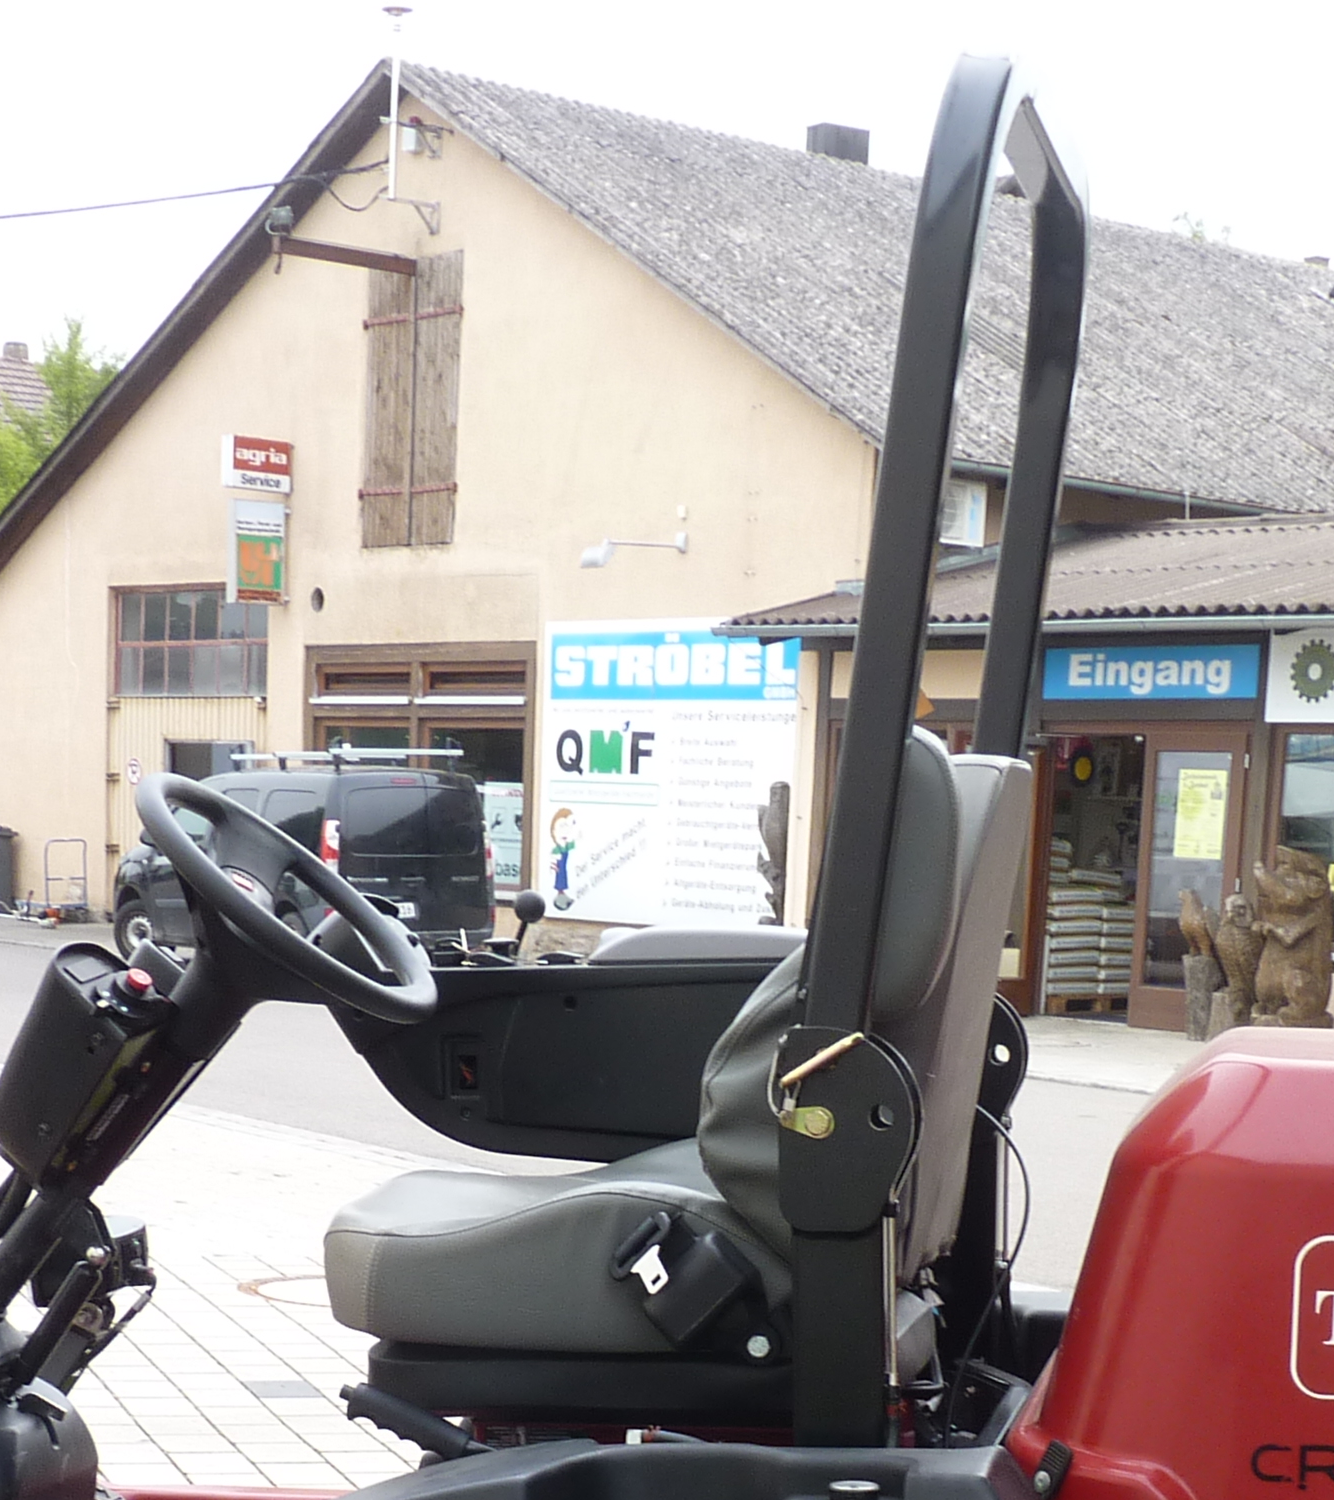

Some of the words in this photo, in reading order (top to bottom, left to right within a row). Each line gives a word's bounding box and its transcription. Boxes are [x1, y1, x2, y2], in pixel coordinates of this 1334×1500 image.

[235, 448, 288, 466] agria
[241, 473, 282, 489] Service
[554, 631, 796, 687] STRÖBEL
[1068, 653, 1231, 695] Eingang
